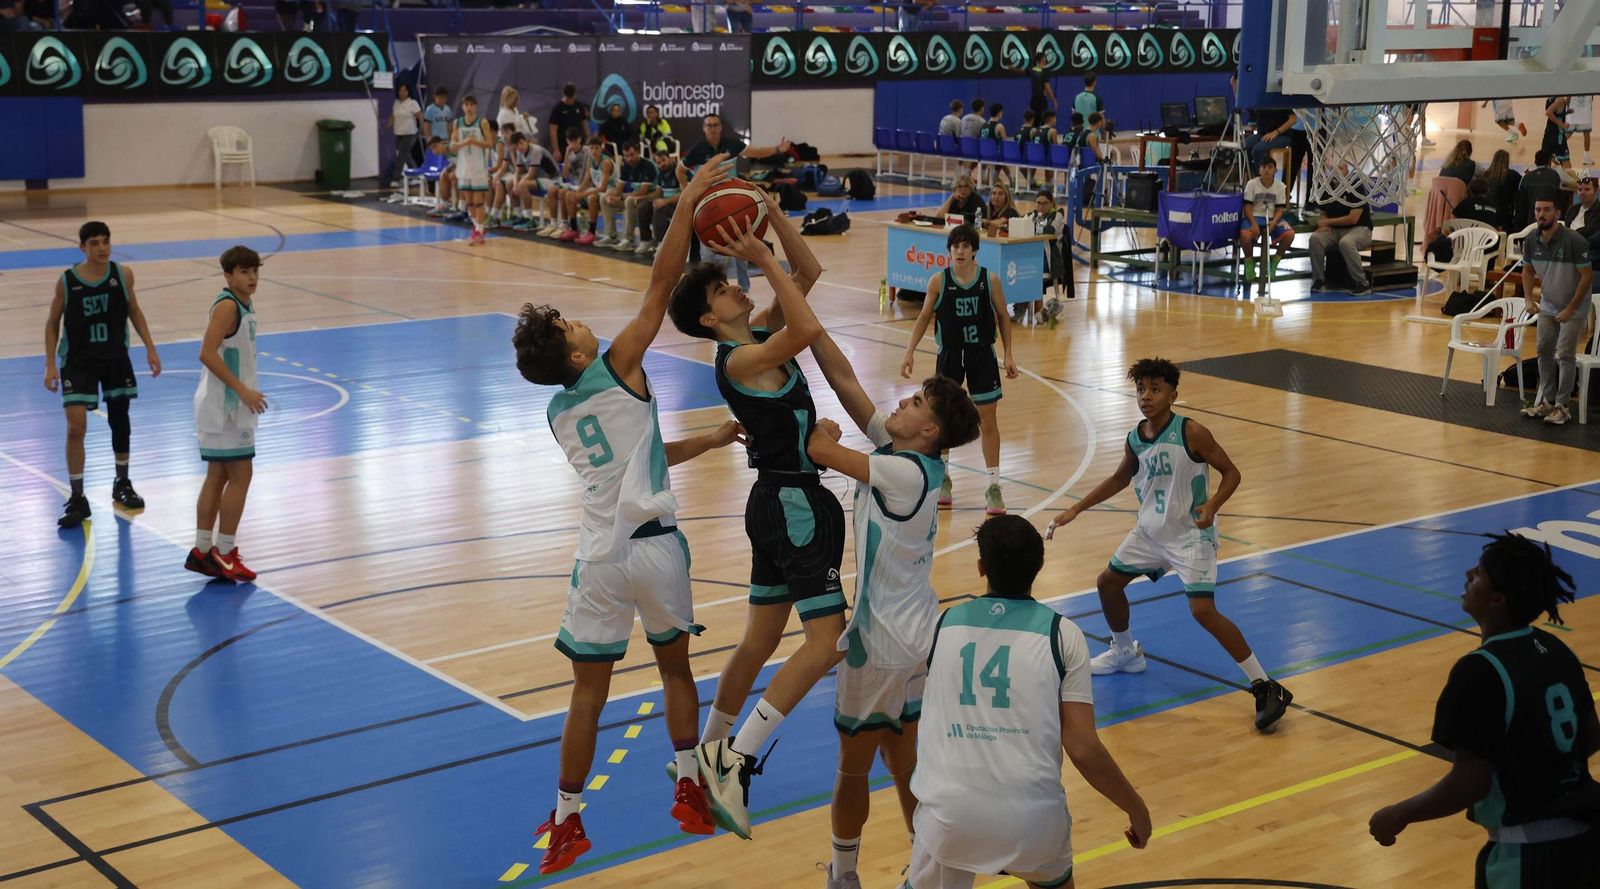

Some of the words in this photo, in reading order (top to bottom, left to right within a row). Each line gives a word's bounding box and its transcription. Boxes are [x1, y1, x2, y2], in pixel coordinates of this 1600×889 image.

[643, 81, 725, 101] baloncesto
[83, 294, 109, 316] SEV
[955, 295, 979, 317] SEV
[90, 323, 108, 342] 10
[962, 324, 979, 344] 12
[576, 414, 615, 469] 9
[1154, 489, 1166, 514] 5
[959, 640, 1011, 709] 14
[1545, 682, 1578, 752] 8
[999, 726, 1030, 735] Provincial
